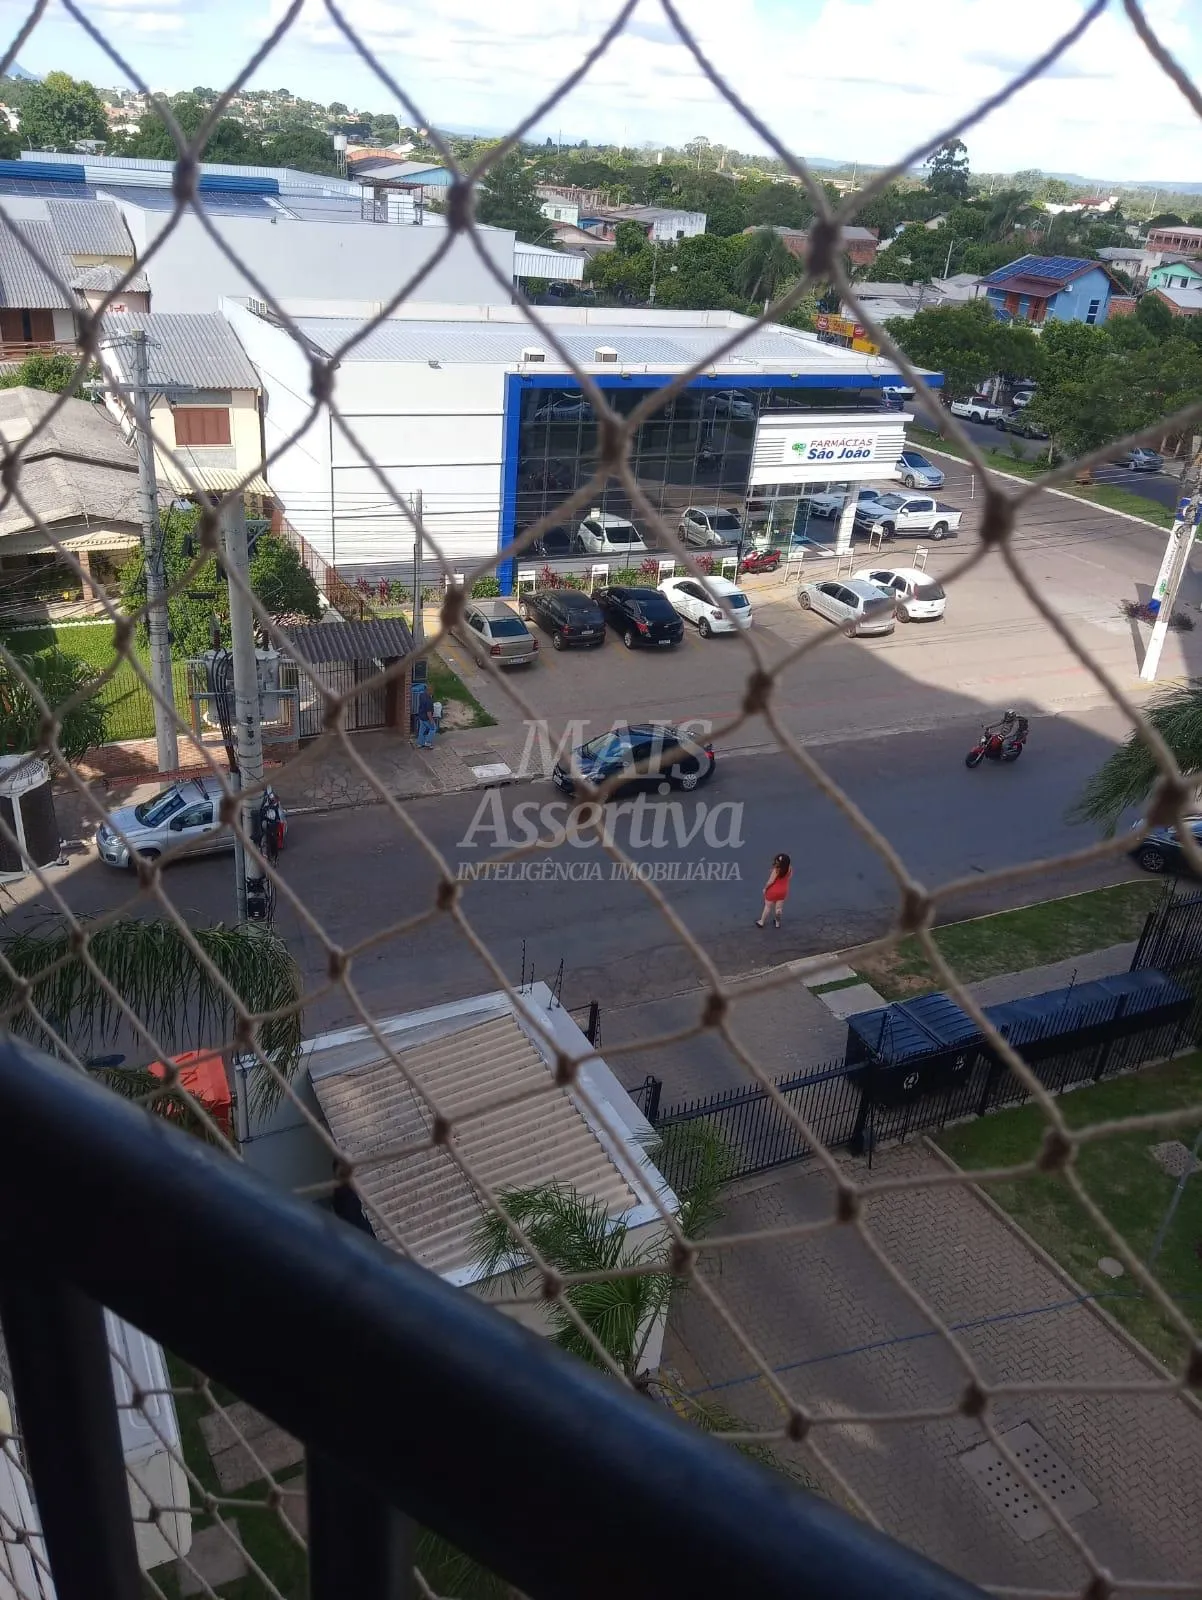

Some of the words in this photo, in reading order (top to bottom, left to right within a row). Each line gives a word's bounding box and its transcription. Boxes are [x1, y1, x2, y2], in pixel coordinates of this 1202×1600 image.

[810, 437, 873, 447] FARMÁCIAS
[807, 447, 834, 459] São
[837, 446, 871, 459] João
